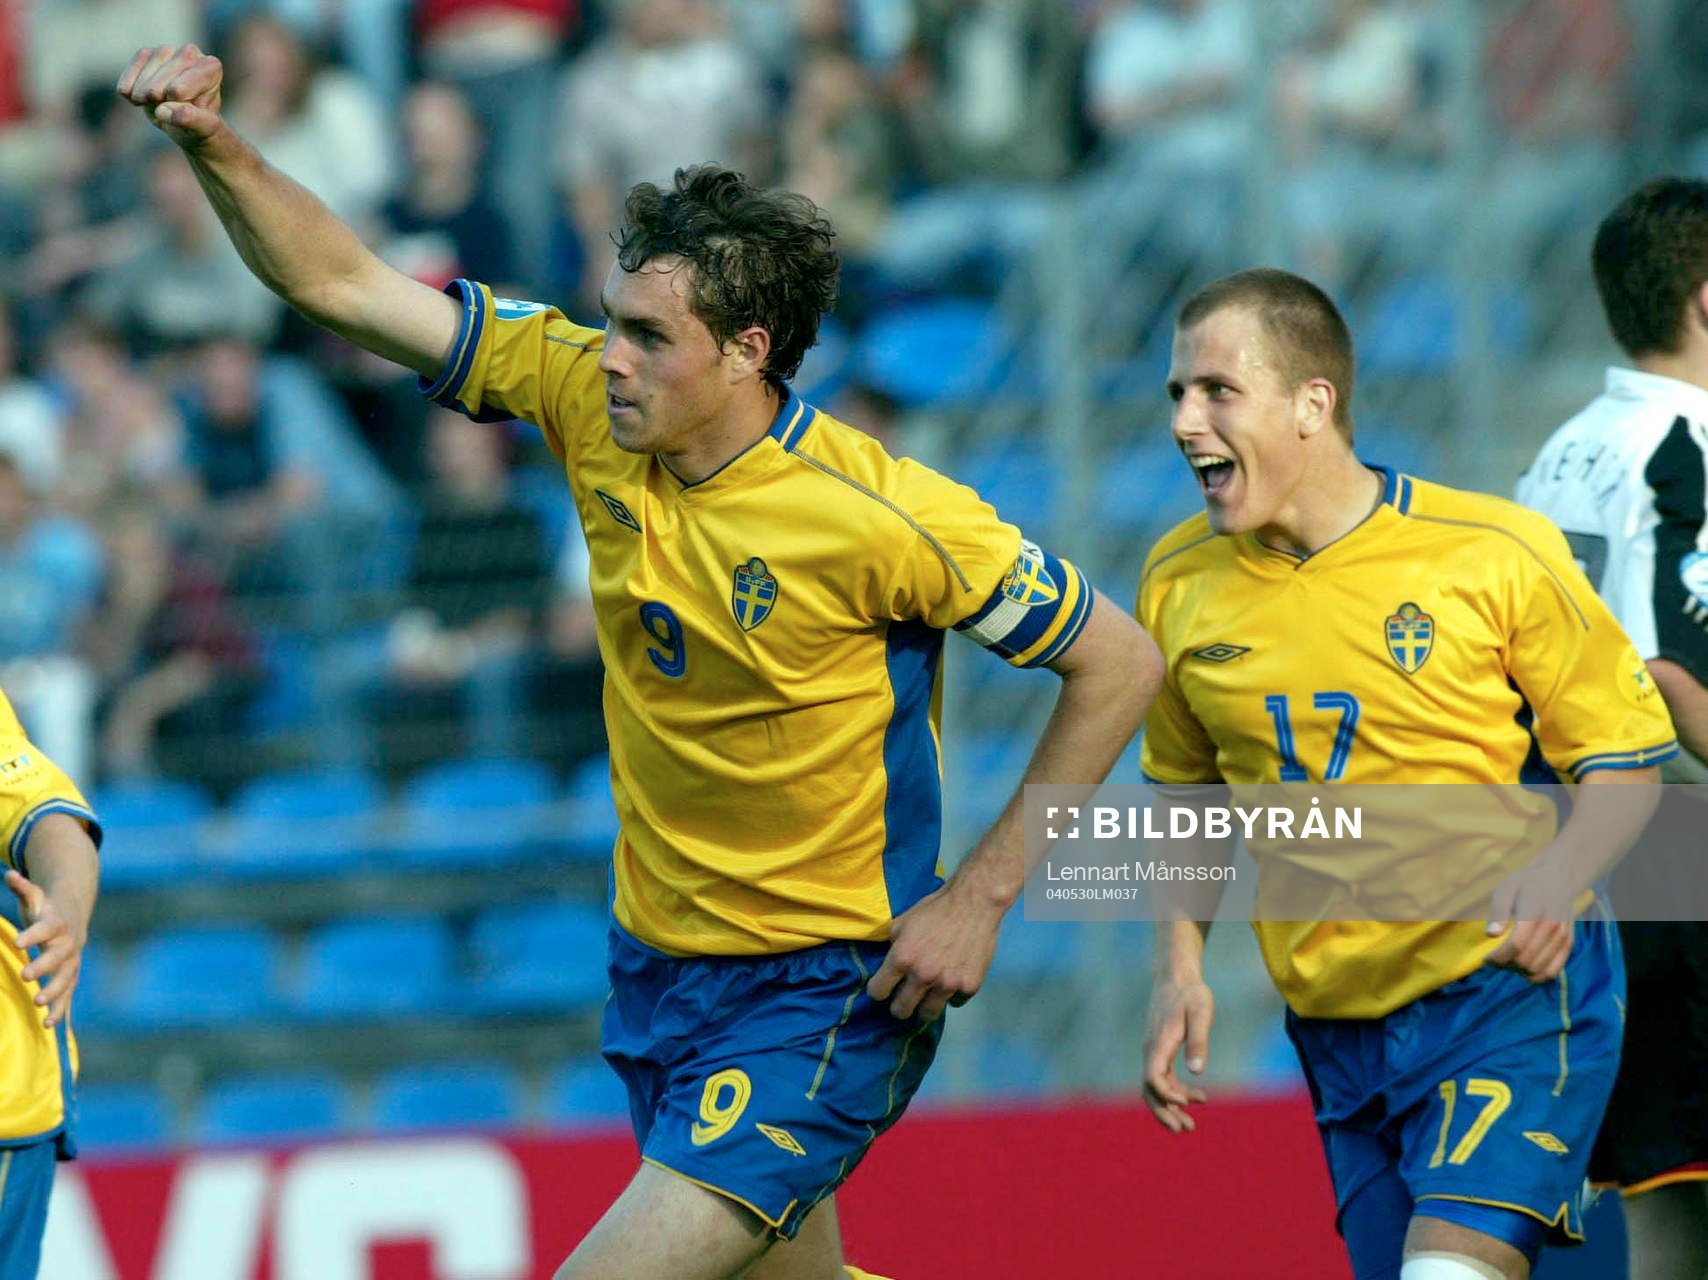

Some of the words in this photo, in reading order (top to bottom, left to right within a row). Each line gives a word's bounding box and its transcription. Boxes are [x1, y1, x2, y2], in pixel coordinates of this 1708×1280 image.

[639, 600, 687, 679] 9
[1264, 691, 1361, 782] 17
[691, 1068, 752, 1146] 9
[1428, 1078, 1512, 1169] 17
